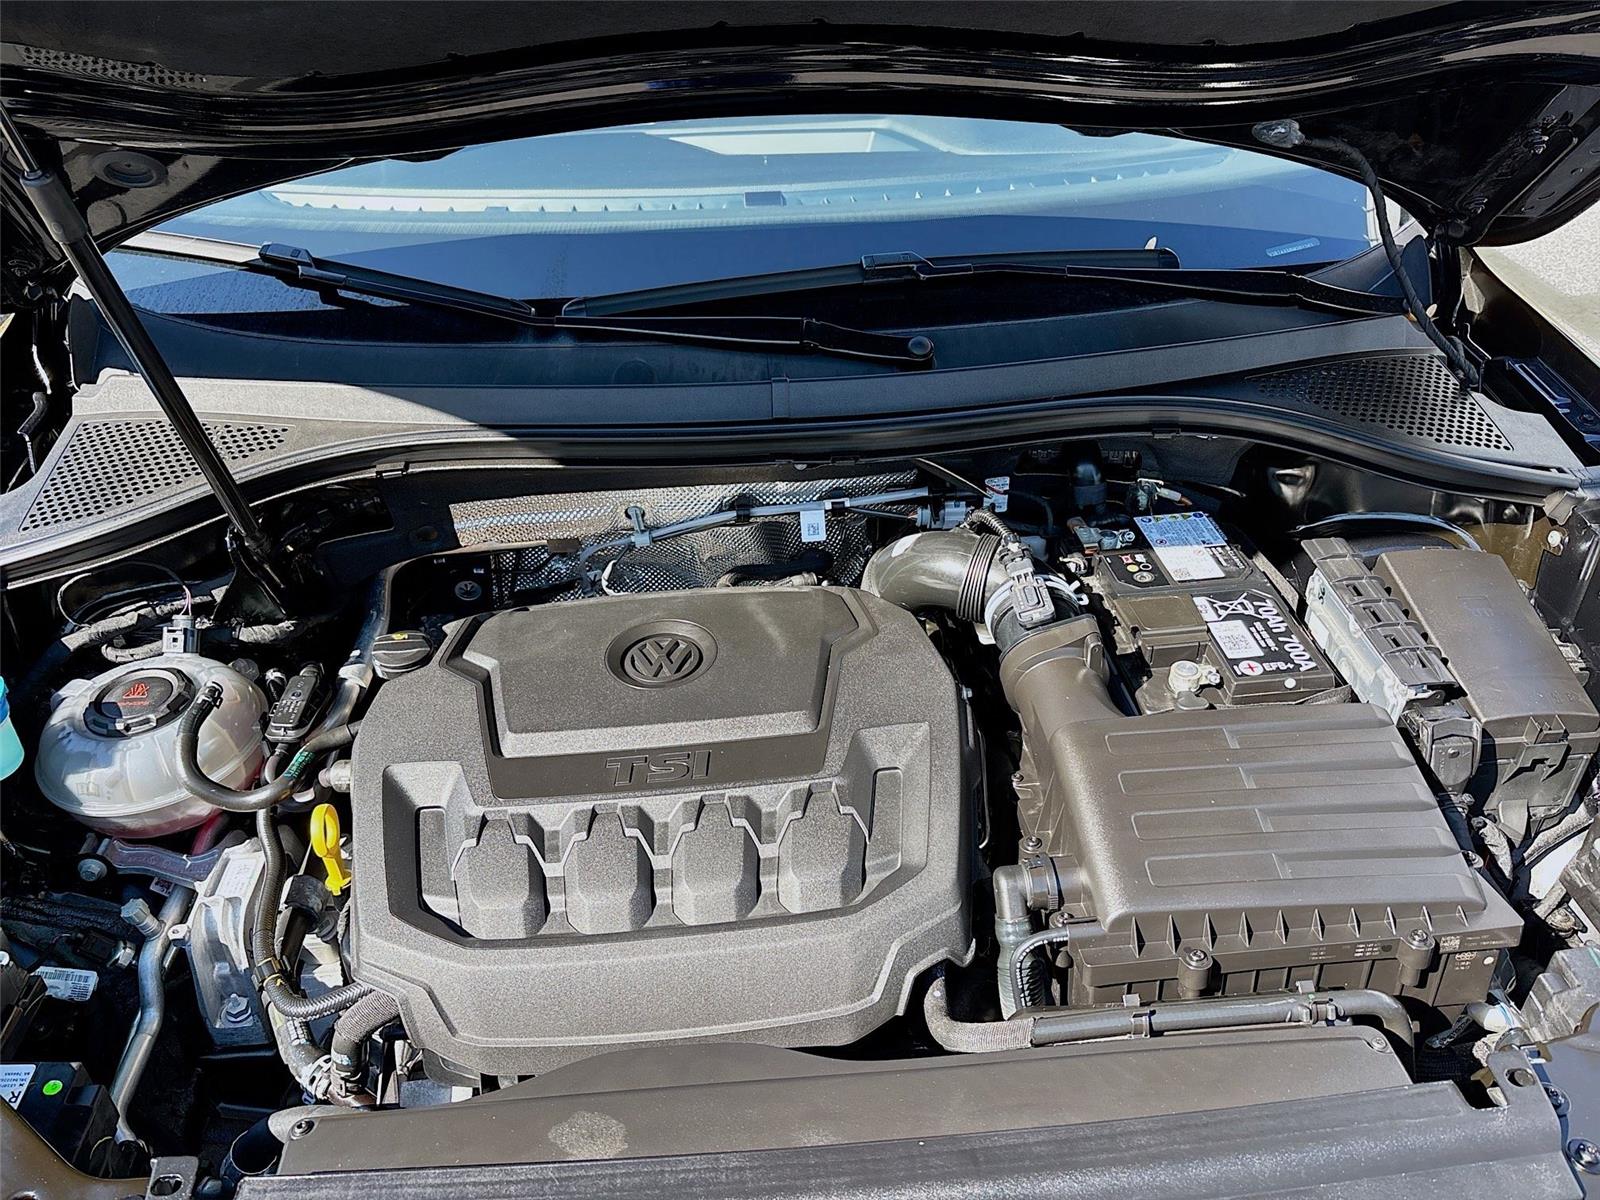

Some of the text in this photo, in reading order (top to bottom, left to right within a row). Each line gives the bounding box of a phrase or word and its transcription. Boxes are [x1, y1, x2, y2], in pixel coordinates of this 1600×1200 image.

[1252, 599, 1288, 633] 70Ah
[1278, 634, 1317, 672] 700A
[606, 750, 711, 786] TSI
